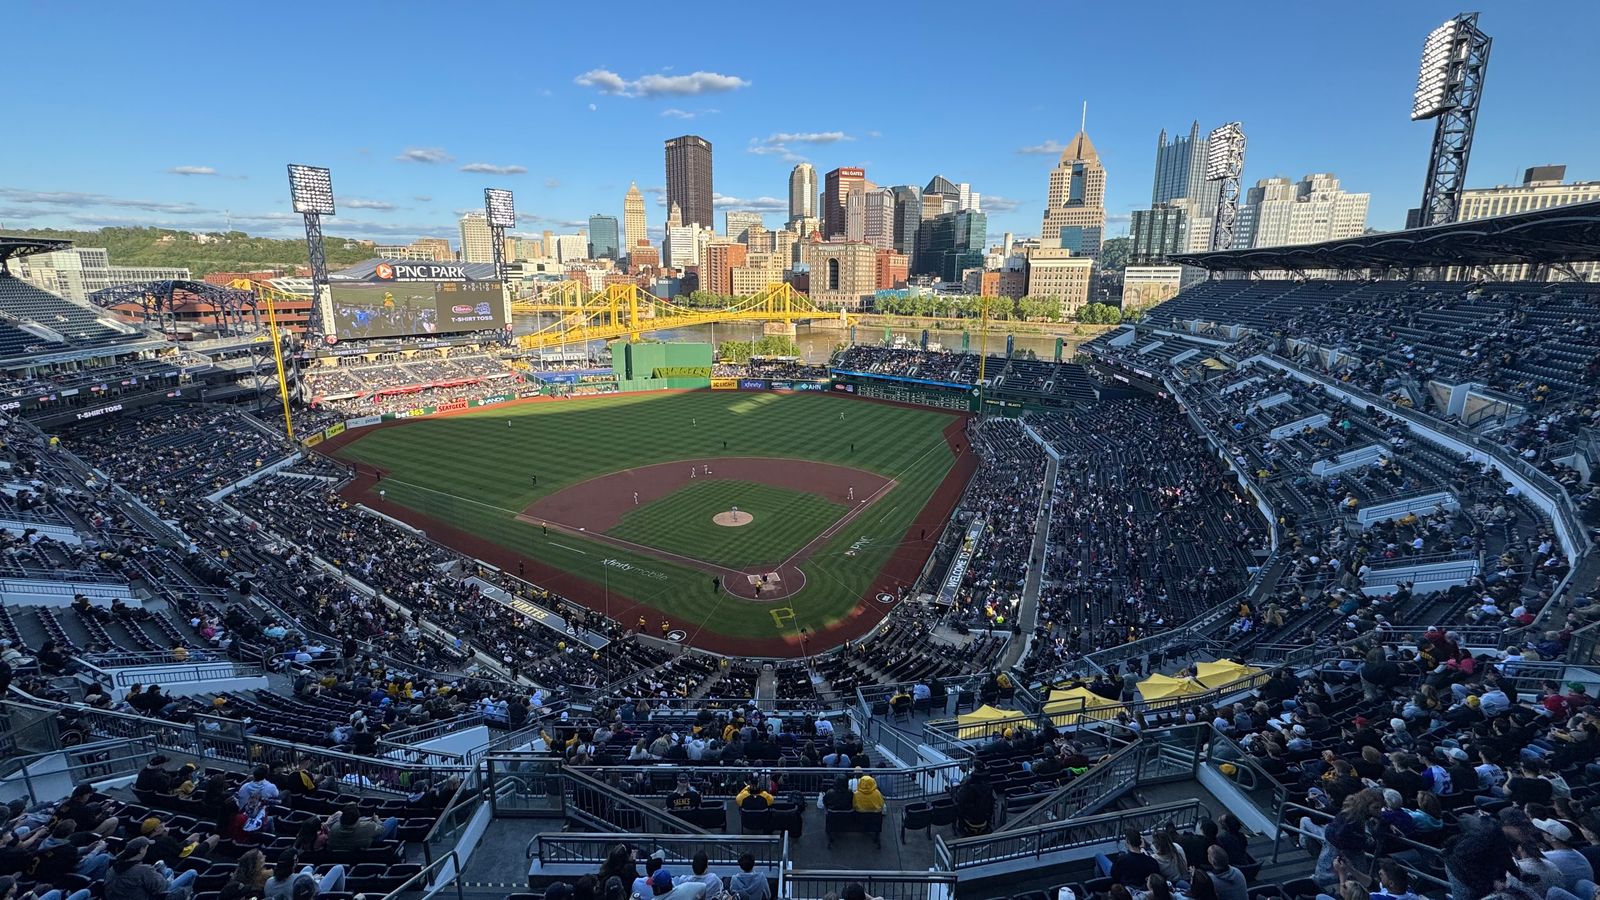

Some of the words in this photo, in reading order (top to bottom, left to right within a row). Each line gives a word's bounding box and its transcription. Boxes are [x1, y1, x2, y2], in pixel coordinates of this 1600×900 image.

[394, 266, 428, 277] PNC
[430, 266, 466, 278] PARK
[0, 402, 20, 410] OSS
[76, 408, 104, 419] T-SHIRT
[104, 404, 122, 414] TOSS
[395, 408, 424, 419] bet365
[438, 402, 466, 412] SEATGEEK
[853, 535, 870, 550] PNC
[601, 559, 634, 570] xfinity
[632, 568, 668, 580] mobile
[947, 560, 967, 588] WELCOME
[511, 599, 549, 620] PIRATES
[769, 608, 796, 628] P
